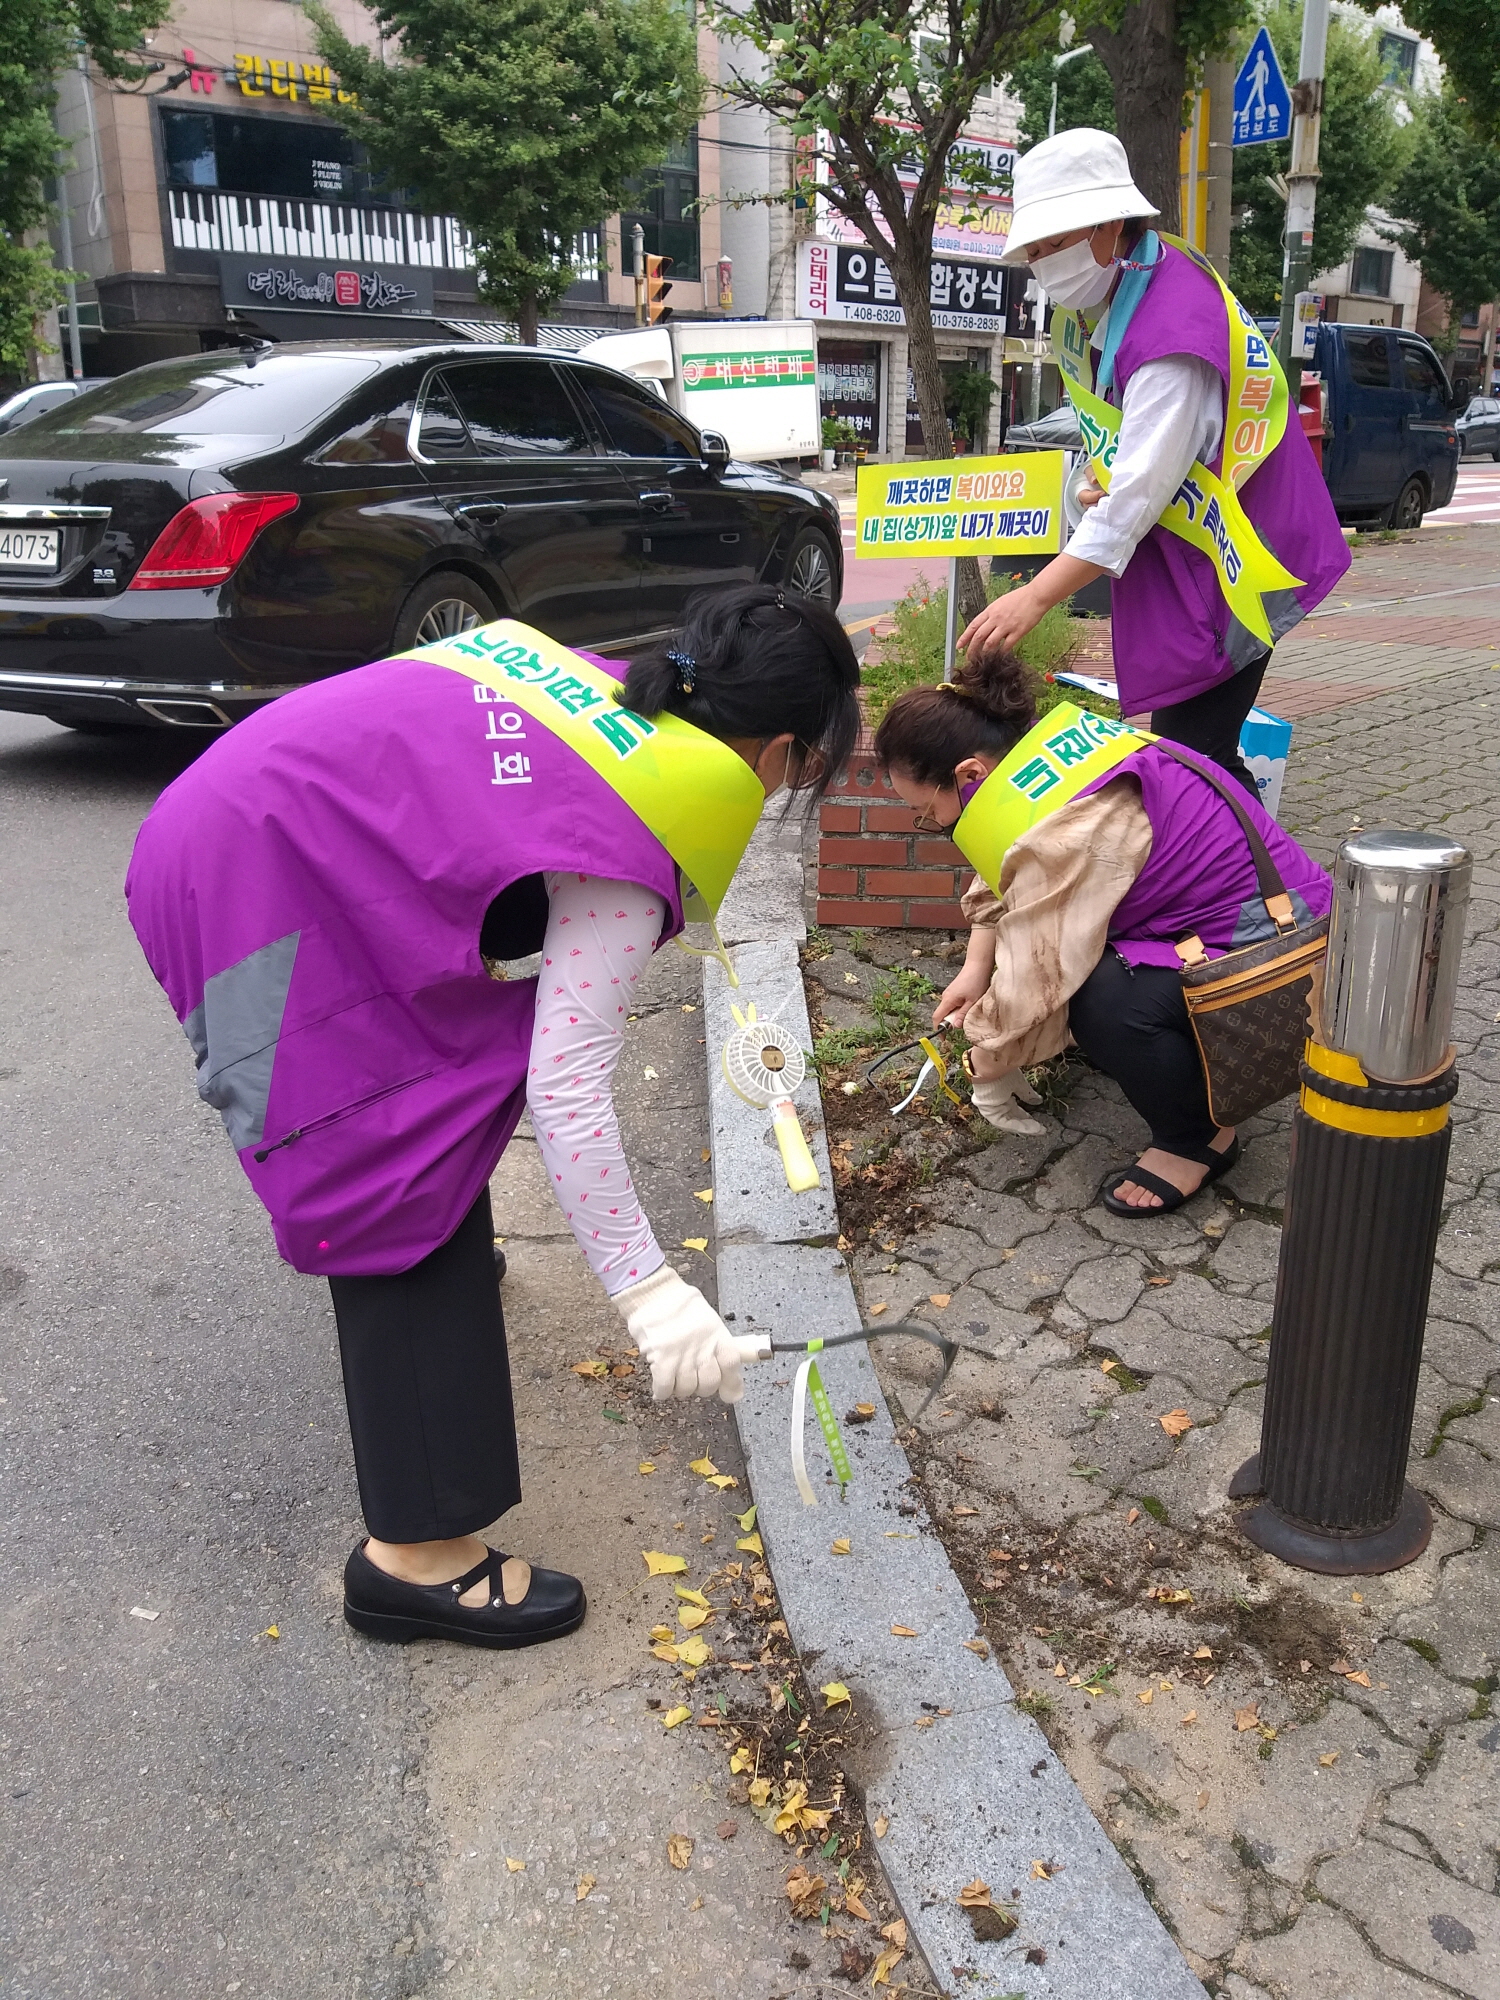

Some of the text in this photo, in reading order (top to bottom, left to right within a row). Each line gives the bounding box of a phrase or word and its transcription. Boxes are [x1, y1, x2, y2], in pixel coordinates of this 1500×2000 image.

[183, 49, 364, 111] 뉴 칸타빌
[1233, 119, 1279, 139] 단보도
[317, 161, 341, 170] PIANO
[809, 247, 828, 315] 인테리어
[844, 253, 1003, 310] 으뜸합장식
[843, 305, 901, 323] T.408-6320
[886, 472, 1025, 504] 깨끗하면 복이와요
[863, 509, 1050, 542] 내 집(상가)앞 내가 깨끗이
[0, 534, 50, 560] 4073
[592, 706, 655, 756] 내
[1011, 756, 1061, 800] 내
